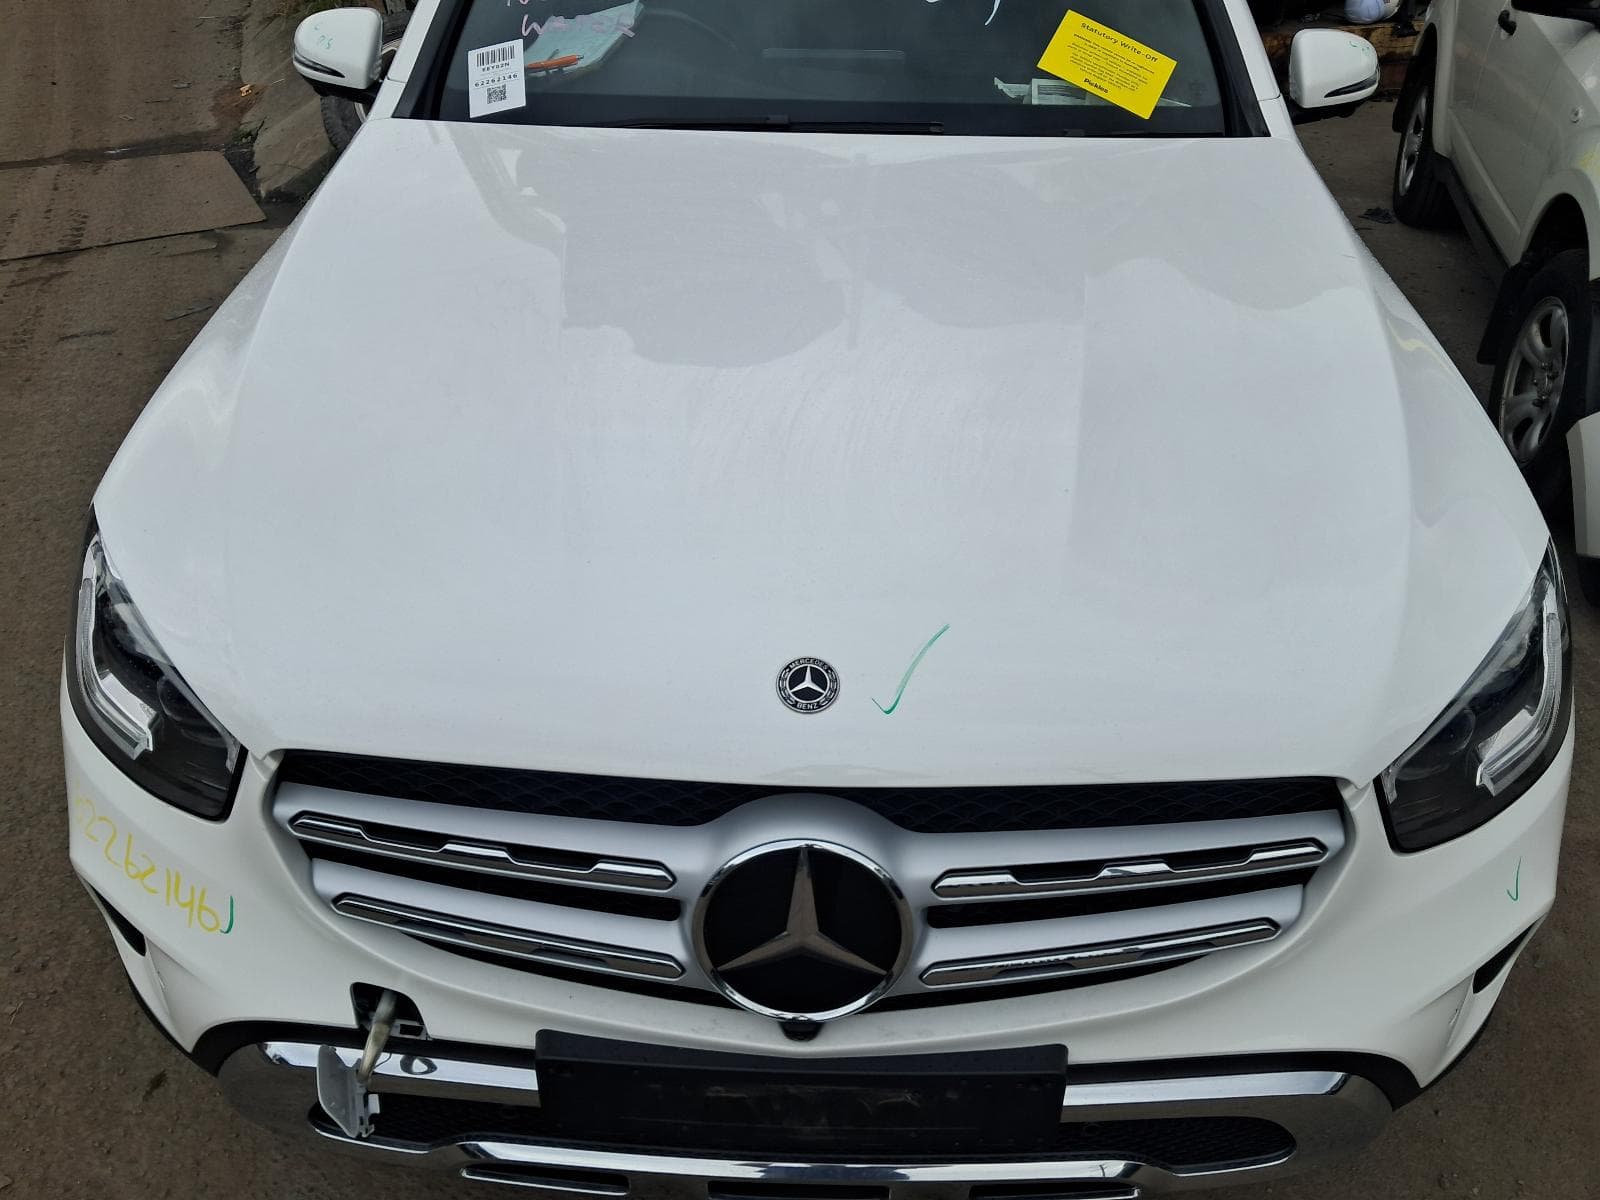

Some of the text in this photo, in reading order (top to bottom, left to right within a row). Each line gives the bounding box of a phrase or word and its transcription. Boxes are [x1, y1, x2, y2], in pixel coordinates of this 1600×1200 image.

[1081, 22, 1158, 62] Statutory Write-Off
[475, 73, 518, 87] 62262146
[1084, 78, 1109, 93] Pickles
[789, 658, 828, 670] MERCEDES
[796, 702, 819, 710] BENZ
